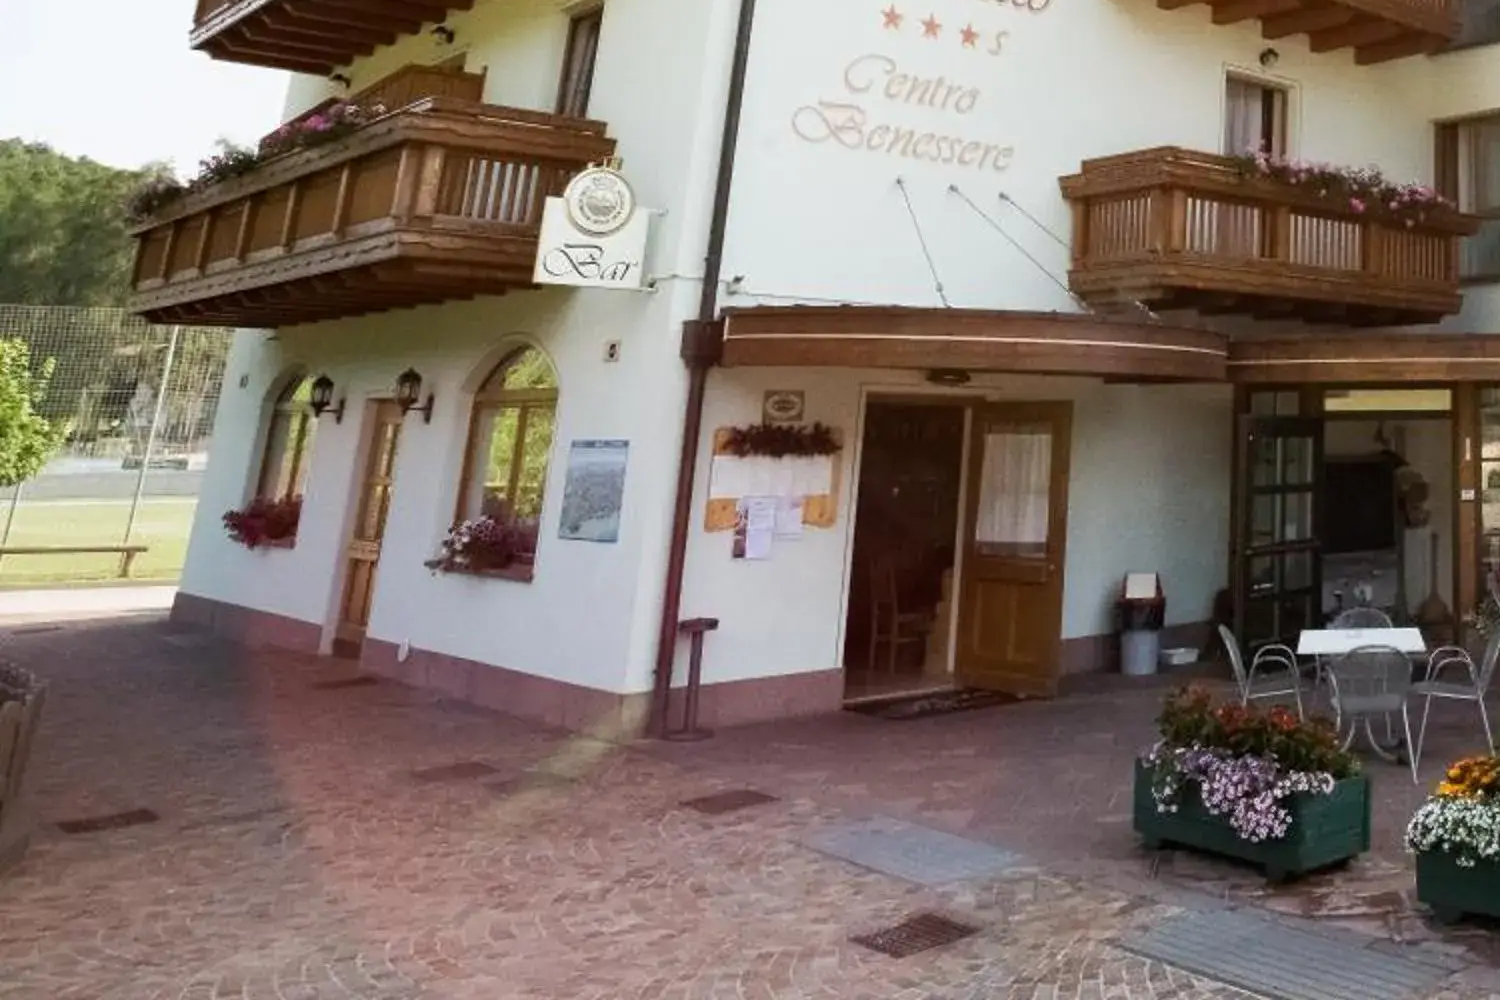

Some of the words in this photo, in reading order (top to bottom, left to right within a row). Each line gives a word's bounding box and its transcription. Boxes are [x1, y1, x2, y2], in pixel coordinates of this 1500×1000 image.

[844, 54, 980, 114] Centro
[791, 97, 1014, 171] Benessere
[543, 243, 639, 281] Bar
